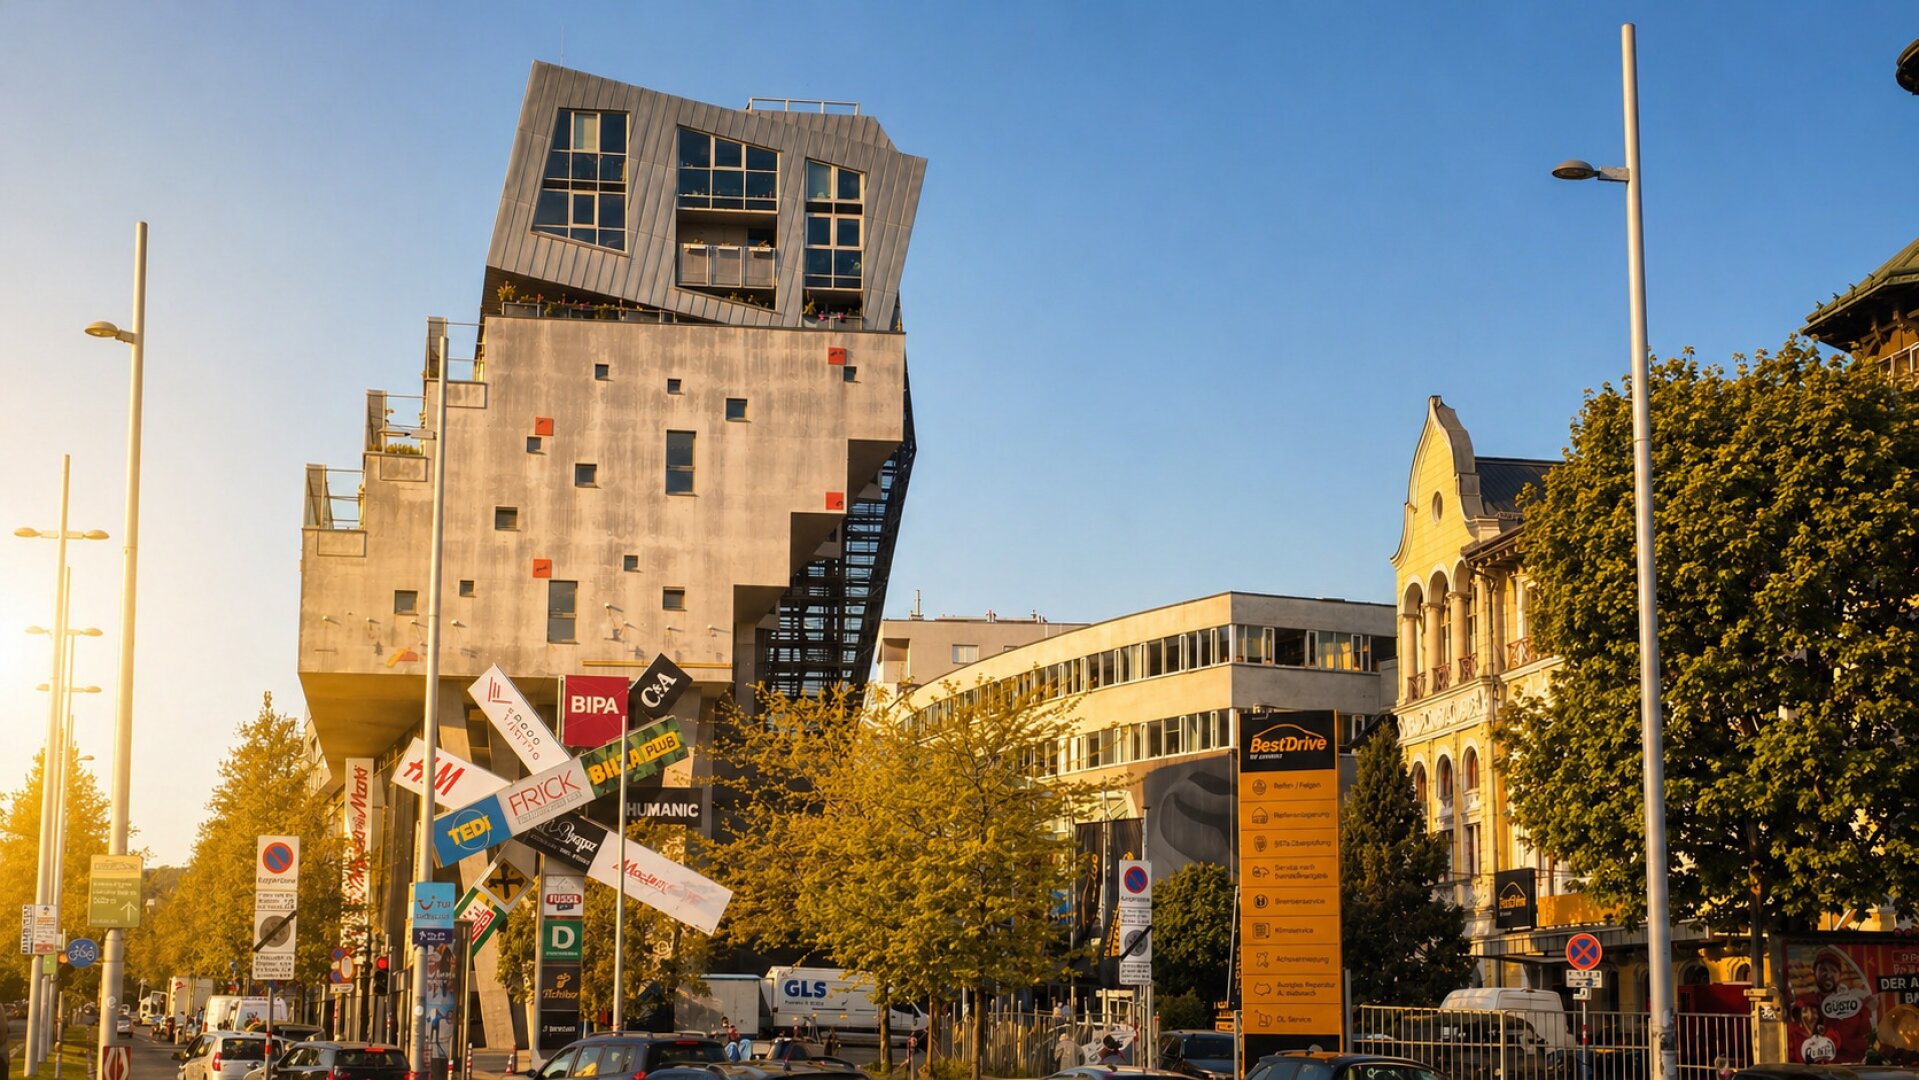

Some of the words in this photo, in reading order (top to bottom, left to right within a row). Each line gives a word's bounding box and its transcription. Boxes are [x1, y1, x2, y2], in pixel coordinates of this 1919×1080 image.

[641, 672, 677, 708] C&A
[571, 695, 620, 715] BIPA
[1249, 734, 1328, 753] BestDrive
[508, 769, 582, 817] FRICK
[626, 802, 699, 818] HUMANIC
[447, 815, 493, 846] TEDI
[551, 925, 576, 950] D
[784, 979, 827, 999] GLS
[1880, 978, 1907, 990] DER
